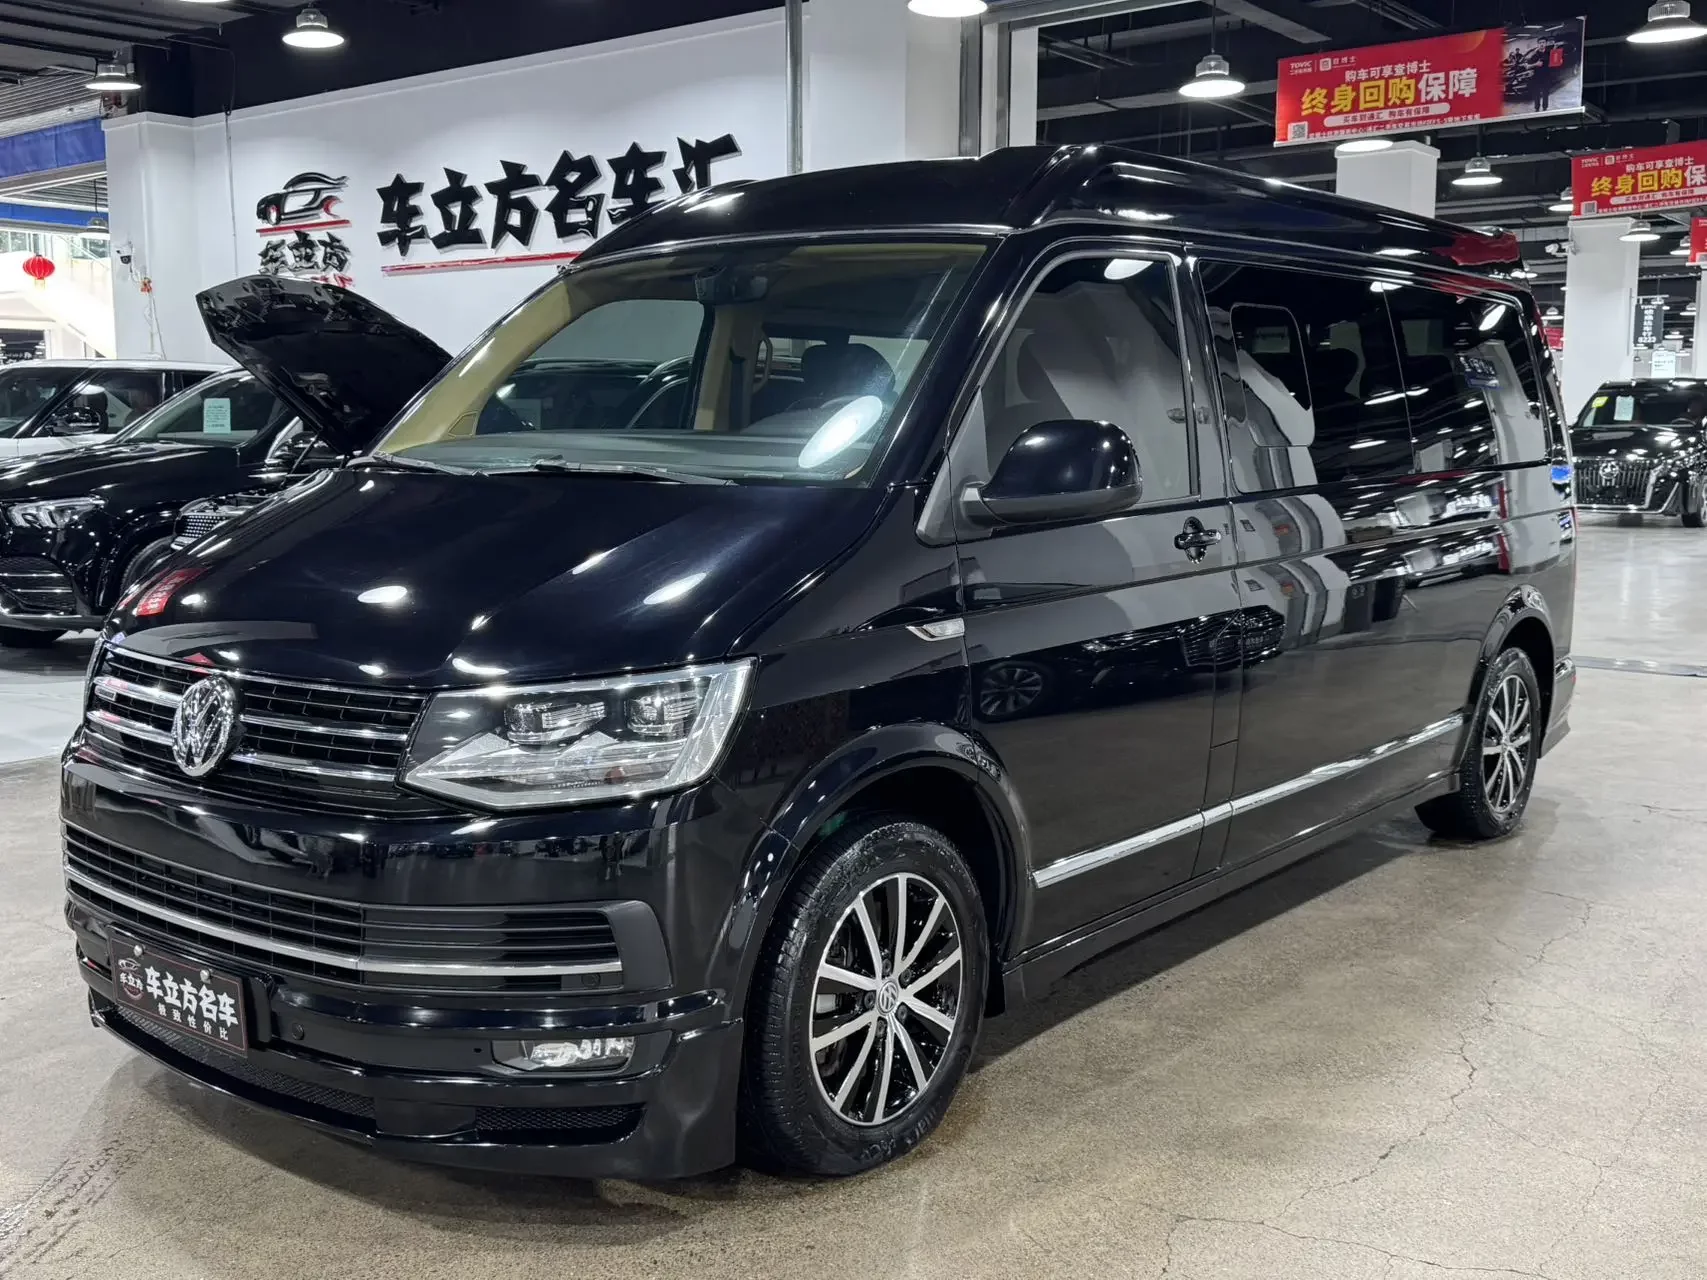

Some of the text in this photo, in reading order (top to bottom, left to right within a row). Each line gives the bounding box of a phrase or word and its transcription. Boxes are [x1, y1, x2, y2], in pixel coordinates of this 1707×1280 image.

[1301, 67, 1478, 116] 终身回购保障
[1345, 60, 1431, 82] 购车可享查博士
[145, 966, 239, 1028] 车立方名车
